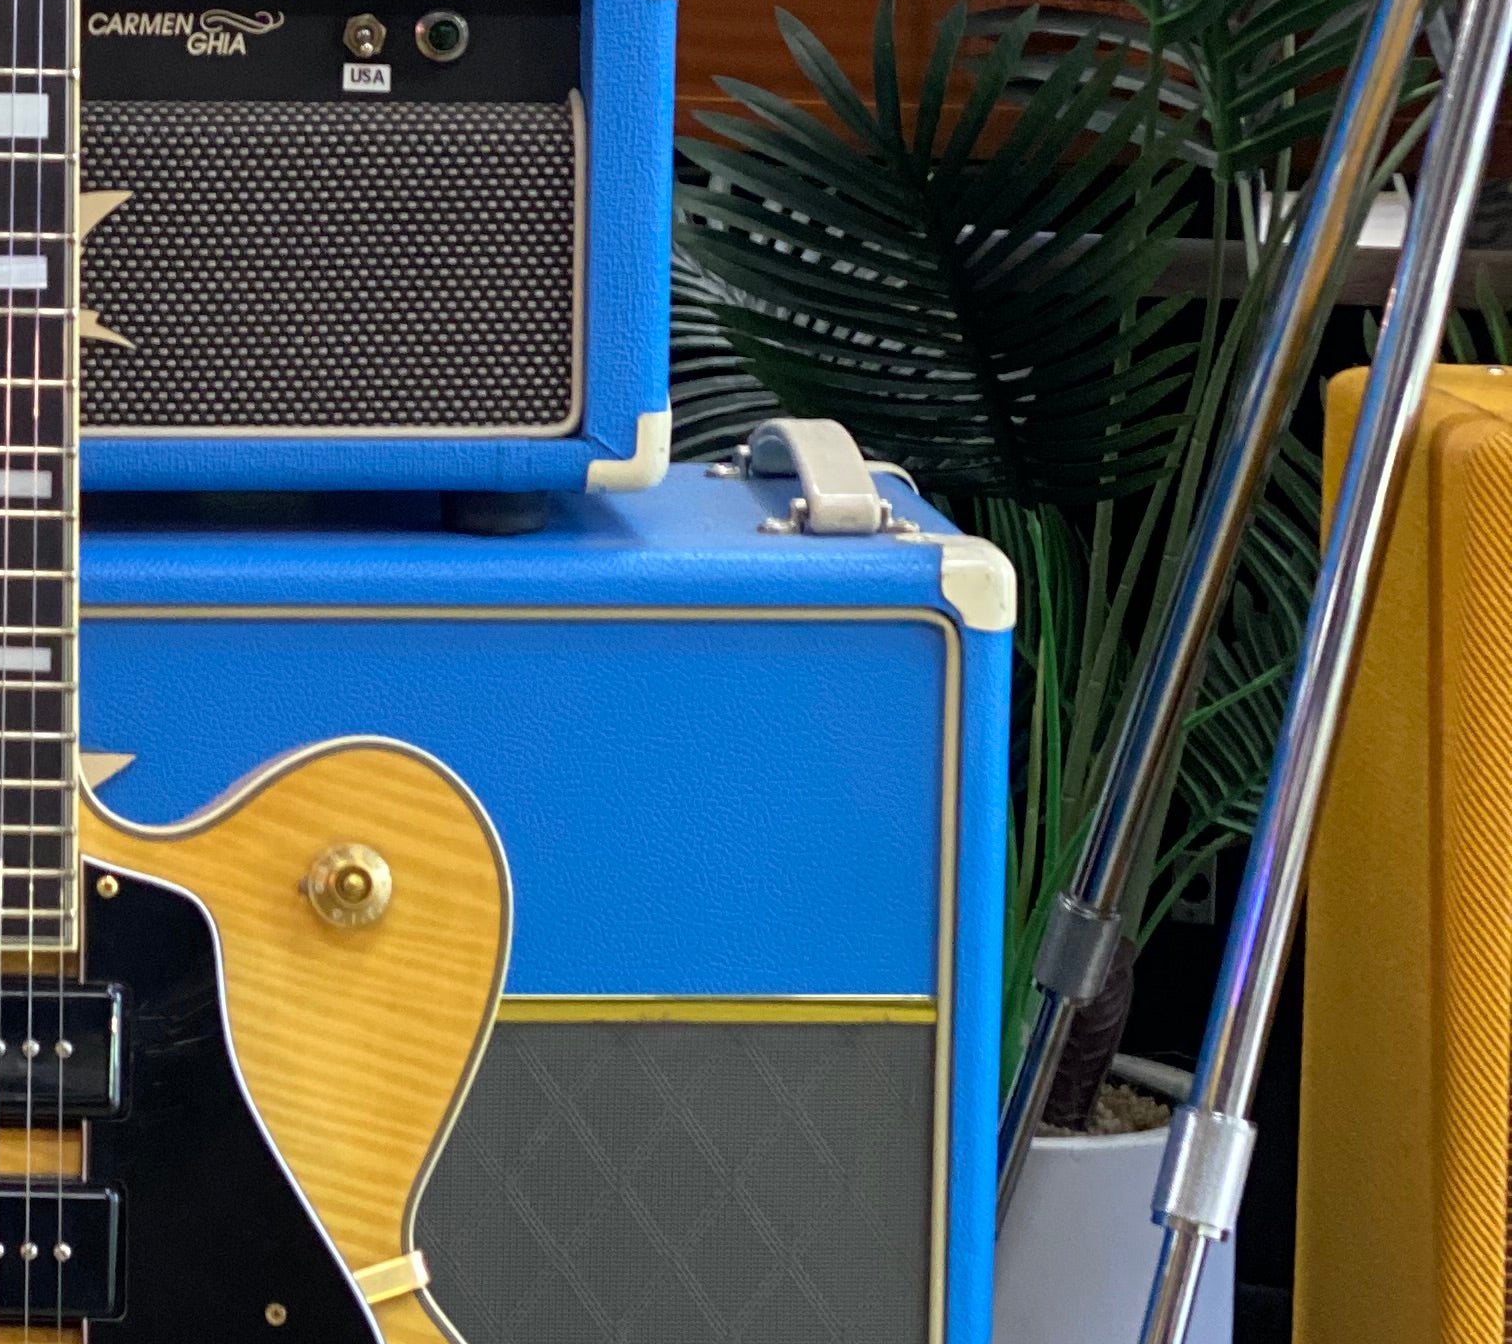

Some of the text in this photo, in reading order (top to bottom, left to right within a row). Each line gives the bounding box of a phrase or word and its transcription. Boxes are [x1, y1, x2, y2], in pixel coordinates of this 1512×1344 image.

[88, 12, 194, 36] CARMEN
[187, 32, 247, 56] GHIA
[350, 67, 385, 84] USA
